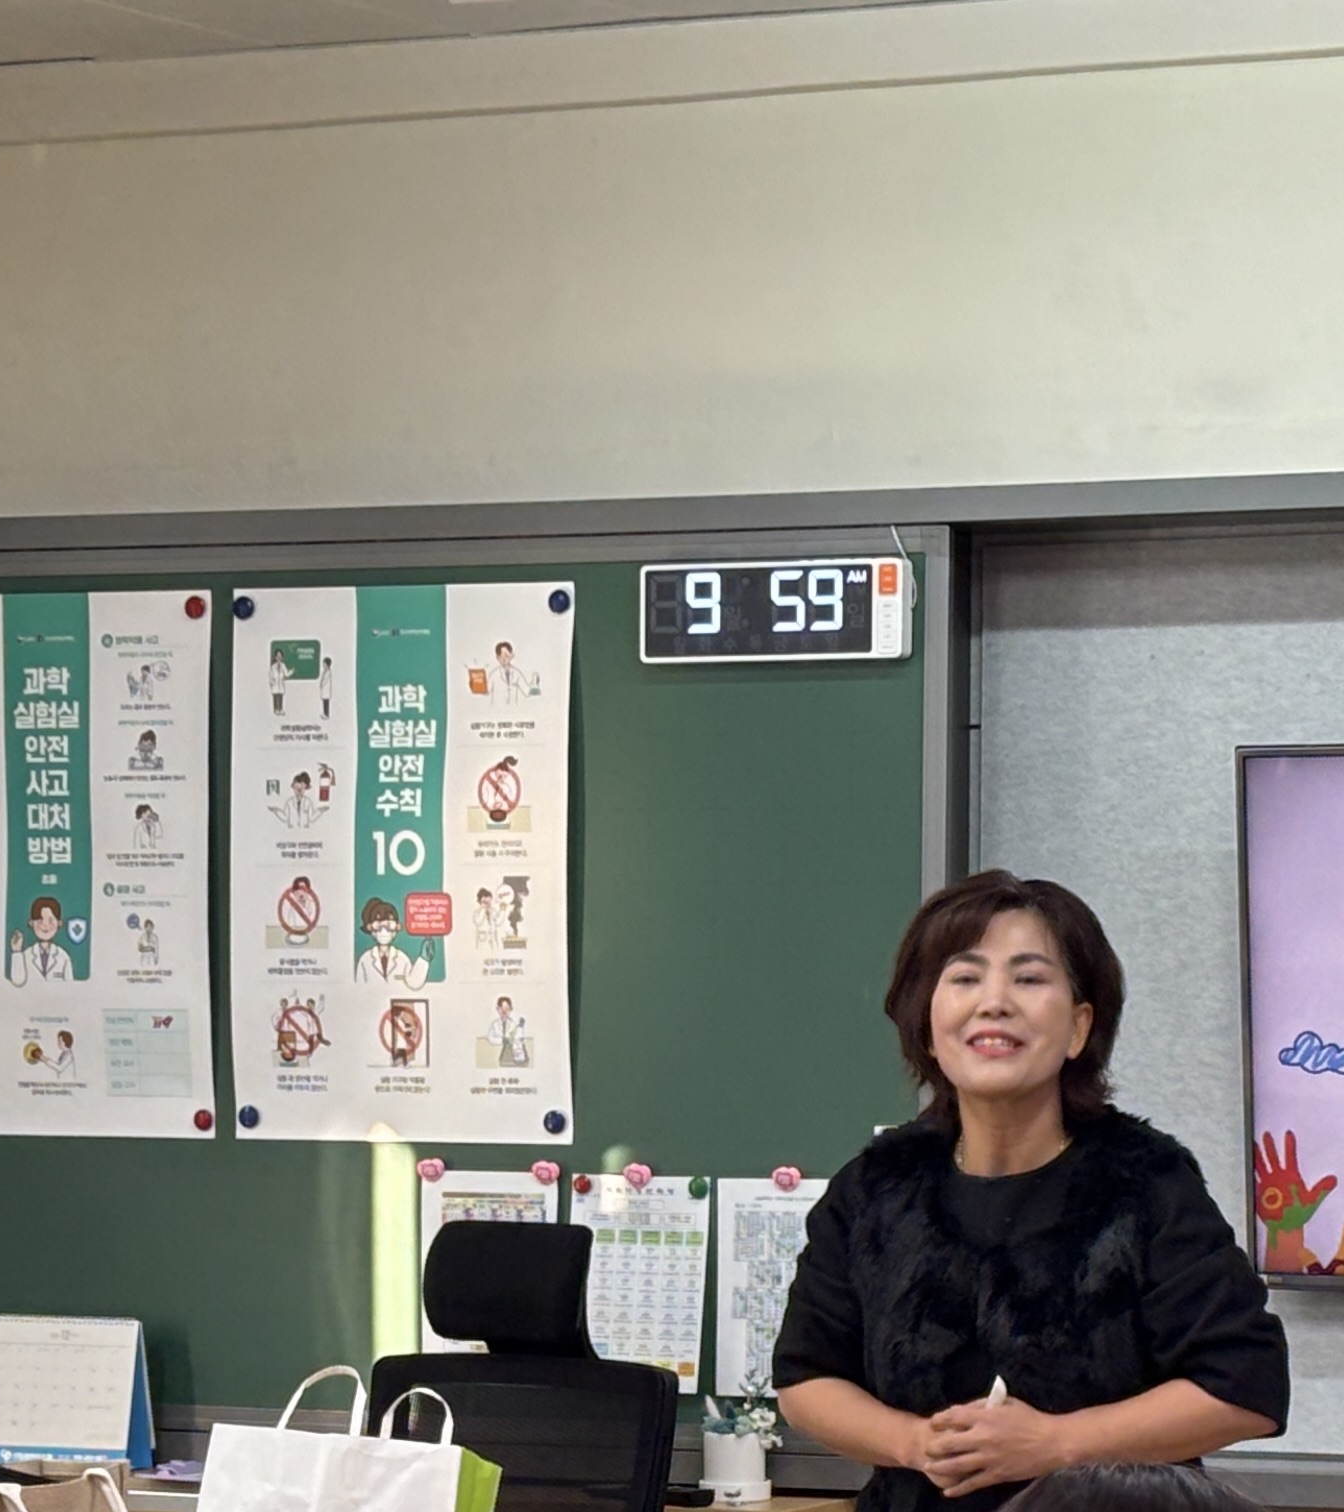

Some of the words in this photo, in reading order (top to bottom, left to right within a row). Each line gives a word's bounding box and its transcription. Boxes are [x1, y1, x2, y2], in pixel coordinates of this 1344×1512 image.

[686, 572, 721, 634] 9
[770, 569, 843, 631] 59
[846, 570, 867, 583] AM
[22, 667, 71, 695] 과학
[377, 684, 427, 713] 과학
[13, 701, 80, 729] 실험실
[367, 719, 437, 748] 실험실
[24, 735, 70, 763] 안전
[378, 754, 425, 783] 안전
[26, 769, 70, 797] 사고
[375, 788, 422, 817] 수칙
[27, 803, 71, 831] 대처
[27, 836, 72, 864] 방법
[372, 830, 426, 876] 10
